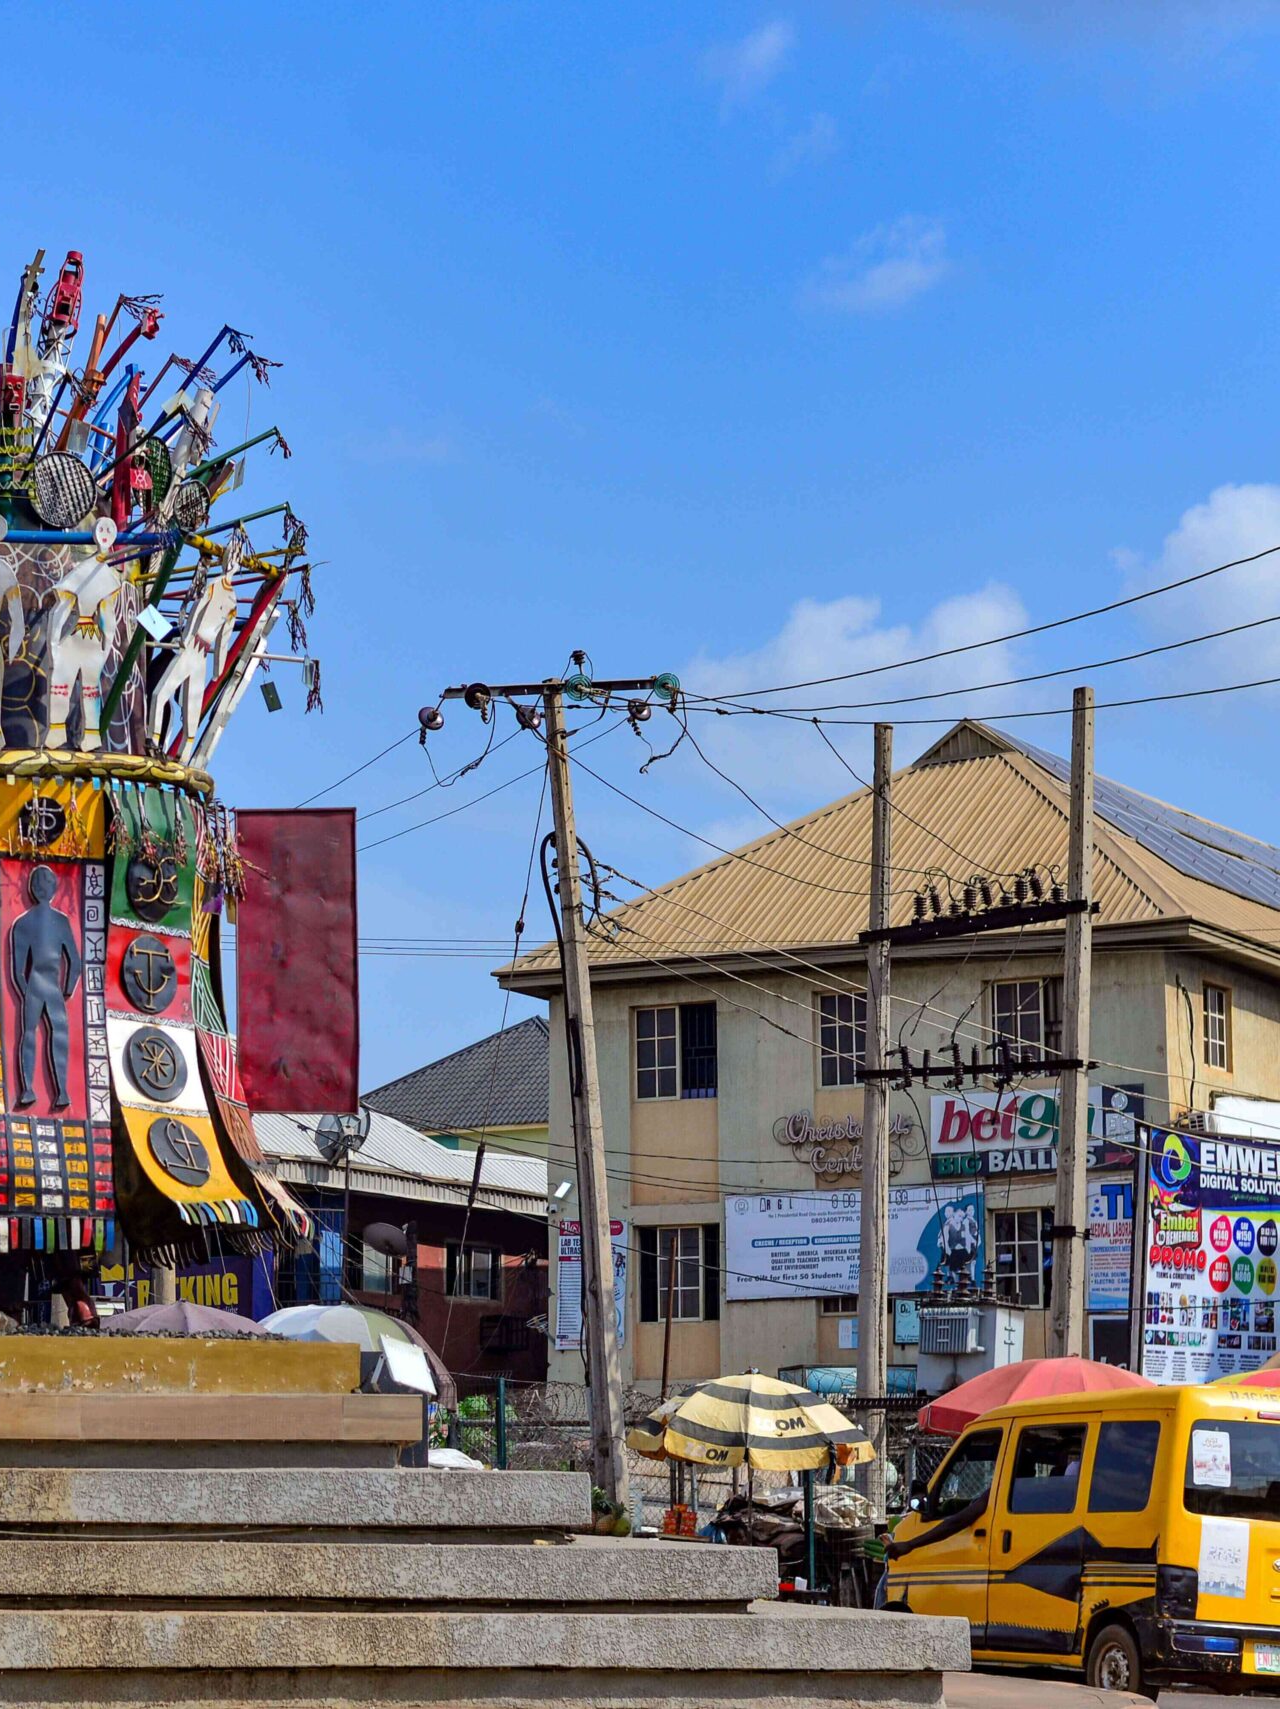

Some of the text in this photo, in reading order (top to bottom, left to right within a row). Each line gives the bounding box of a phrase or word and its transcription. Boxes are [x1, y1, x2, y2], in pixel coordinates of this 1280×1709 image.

[937, 1148, 1097, 1175] BIG BALLS
[1200, 1174, 1239, 1192] DIGITAL
[1090, 1223, 1110, 1238] MEDICAL
[1161, 1213, 1198, 1231] Ember
[1150, 1244, 1207, 1272] PROMO
[137, 1273, 238, 1307] BKING
